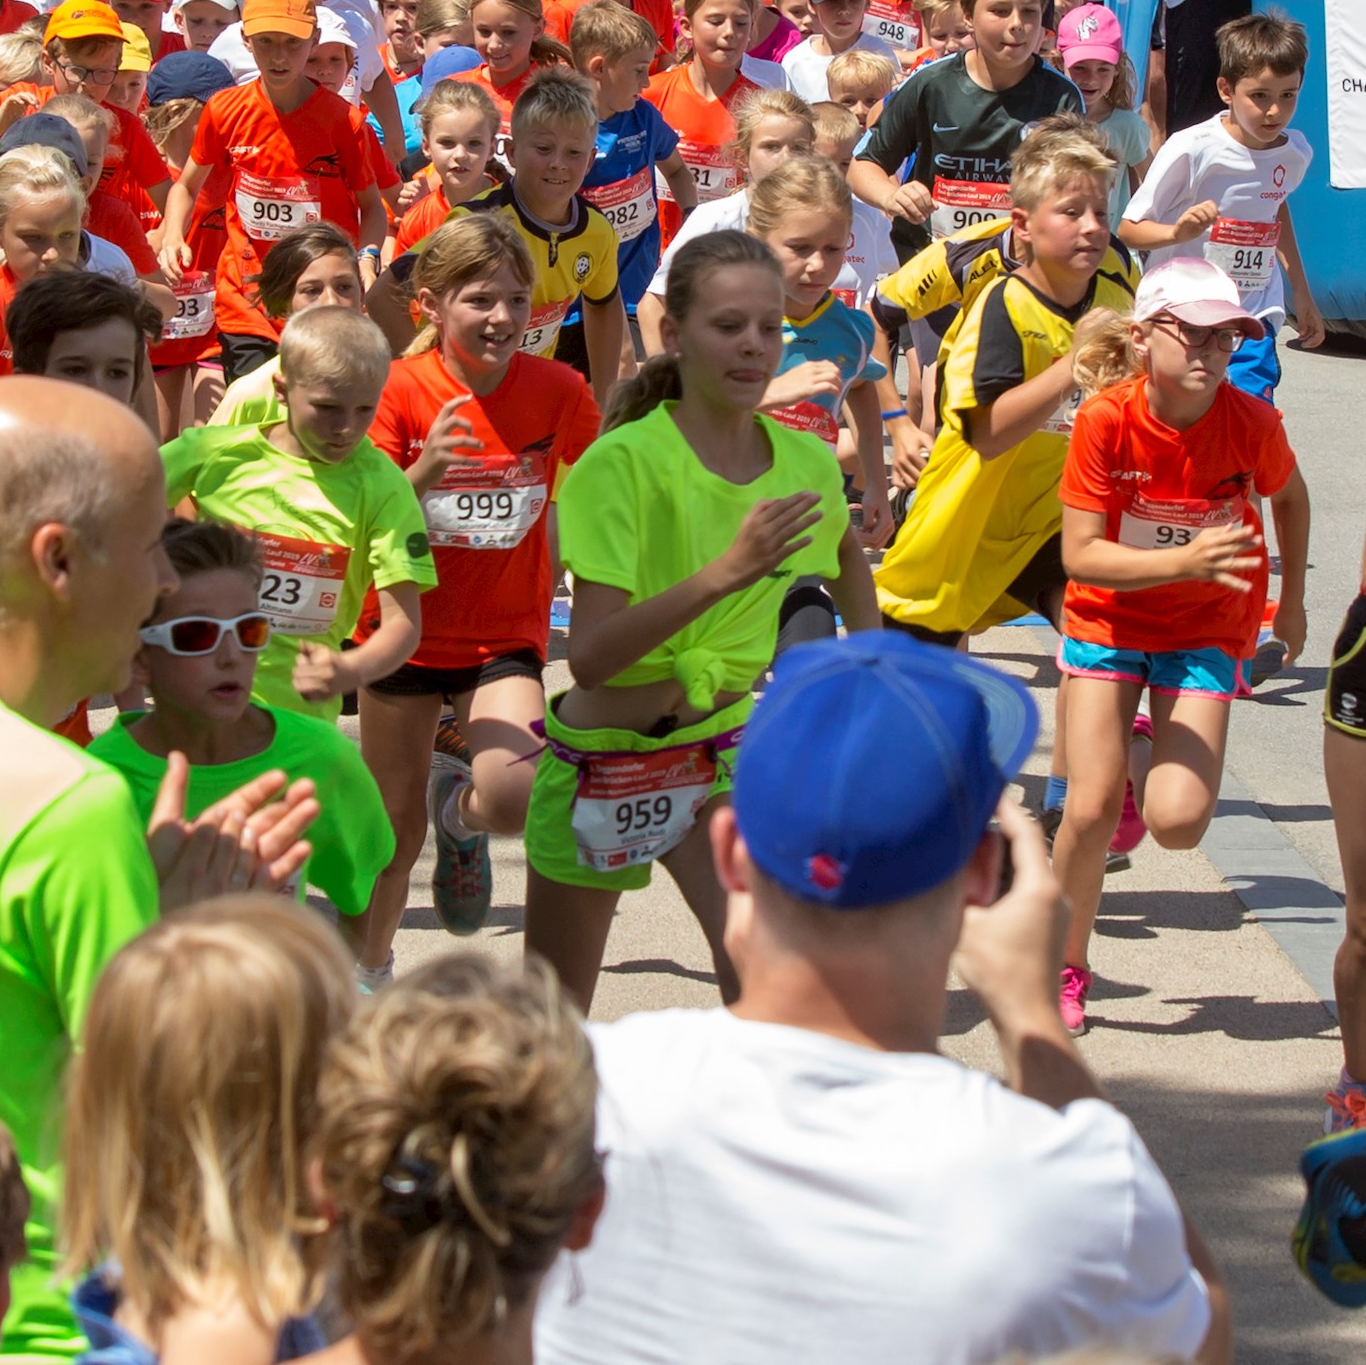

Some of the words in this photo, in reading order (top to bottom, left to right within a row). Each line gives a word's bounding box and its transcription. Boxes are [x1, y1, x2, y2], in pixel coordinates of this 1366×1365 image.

[878, 21, 905, 41] 948
[1260, 190, 1287, 200] conga
[253, 201, 293, 223] 903
[605, 202, 639, 225] 982
[842, 255, 865, 265] gatec
[1233, 249, 1263, 270] 914
[457, 493, 513, 520] 999
[1156, 525, 1191, 546] 93
[260, 574, 302, 605] 23
[596, 762, 645, 774] Deggendorfer
[616, 795, 672, 835] 959
